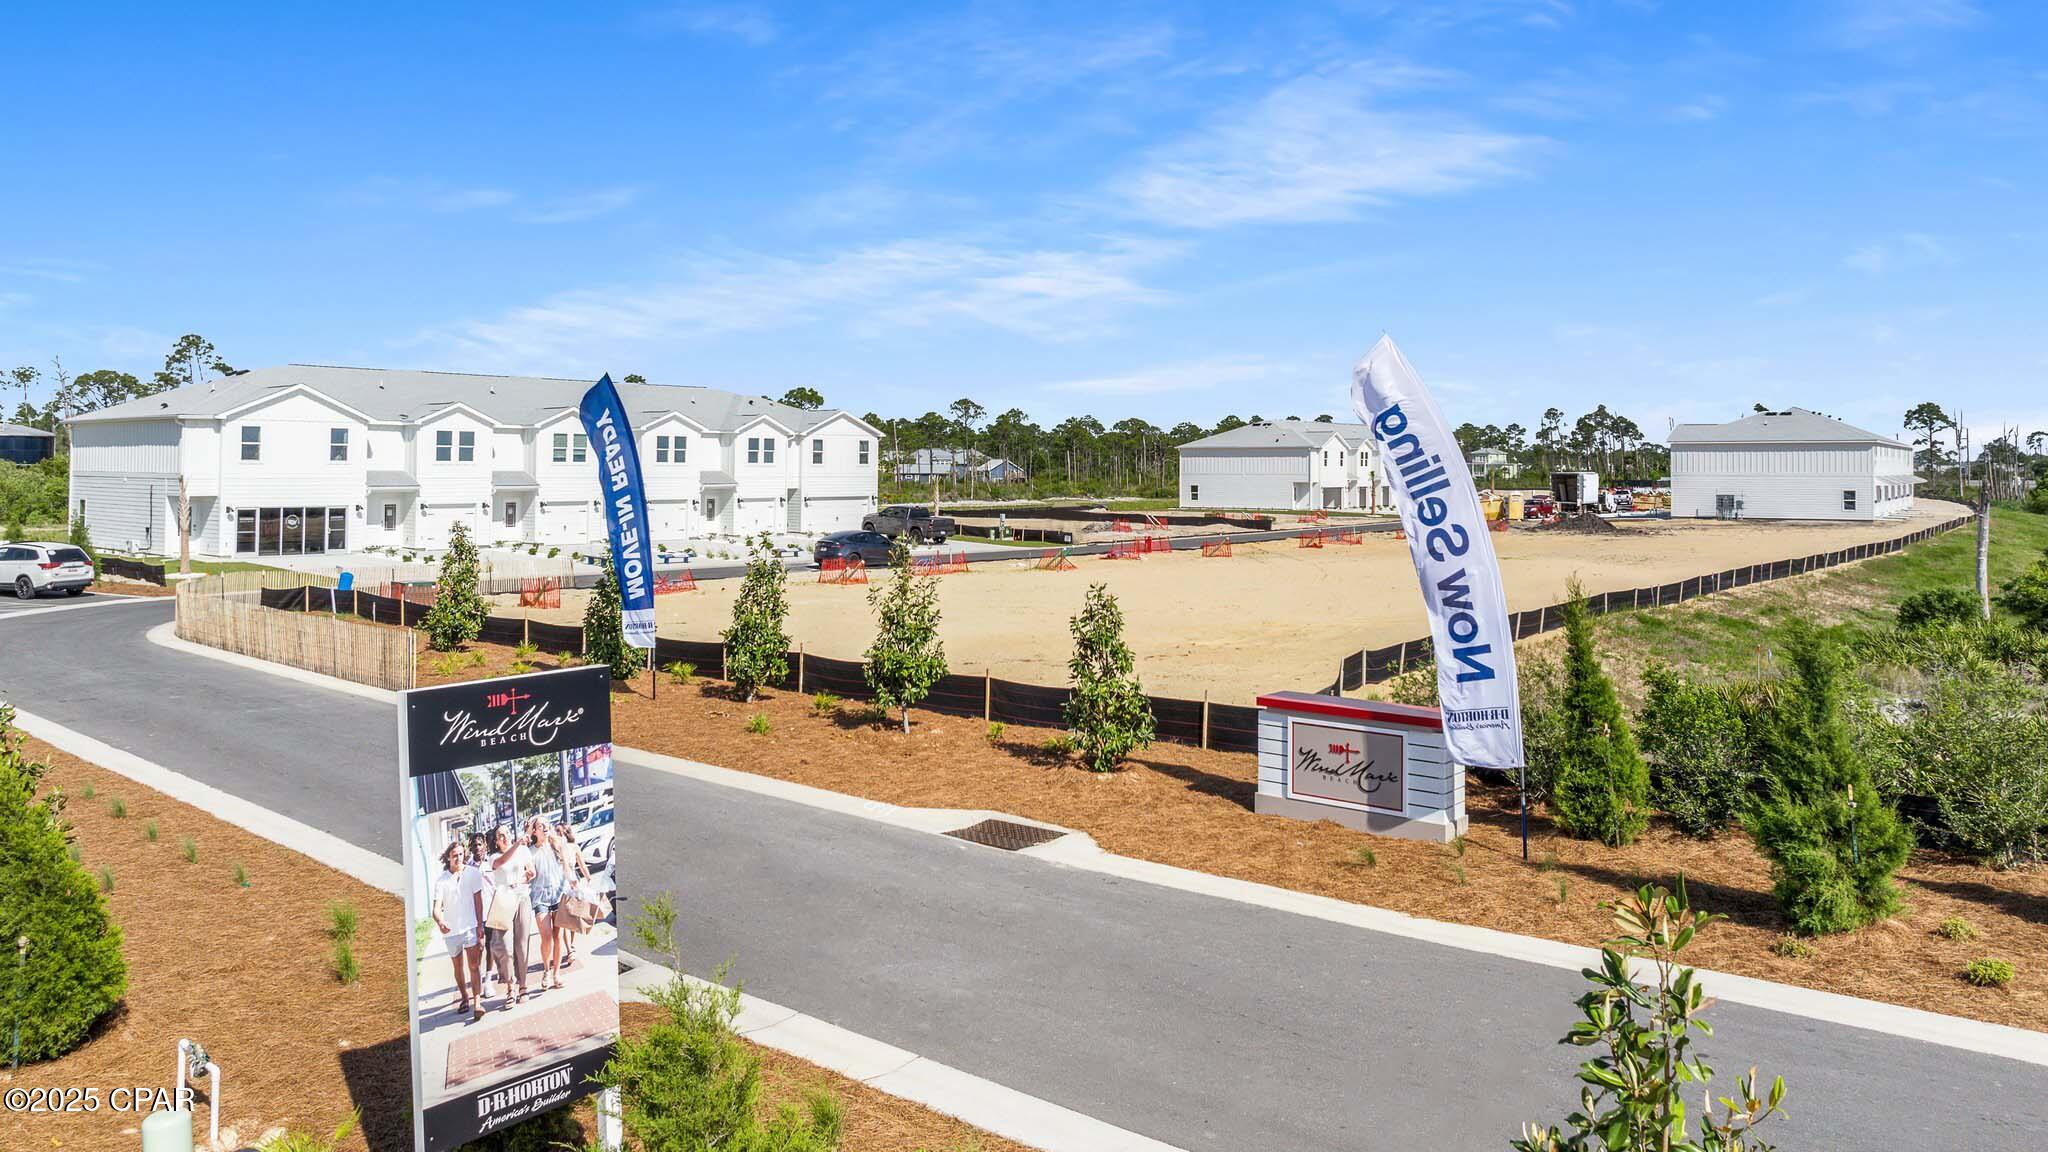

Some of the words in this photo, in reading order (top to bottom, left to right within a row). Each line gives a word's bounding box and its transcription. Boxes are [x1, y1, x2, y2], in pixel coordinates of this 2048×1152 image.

[480, 732, 527, 747] BEACH
[1322, 774, 1359, 785] BEACH
[479, 1105, 530, 1134] America's
[531, 1090, 572, 1112] Builder
